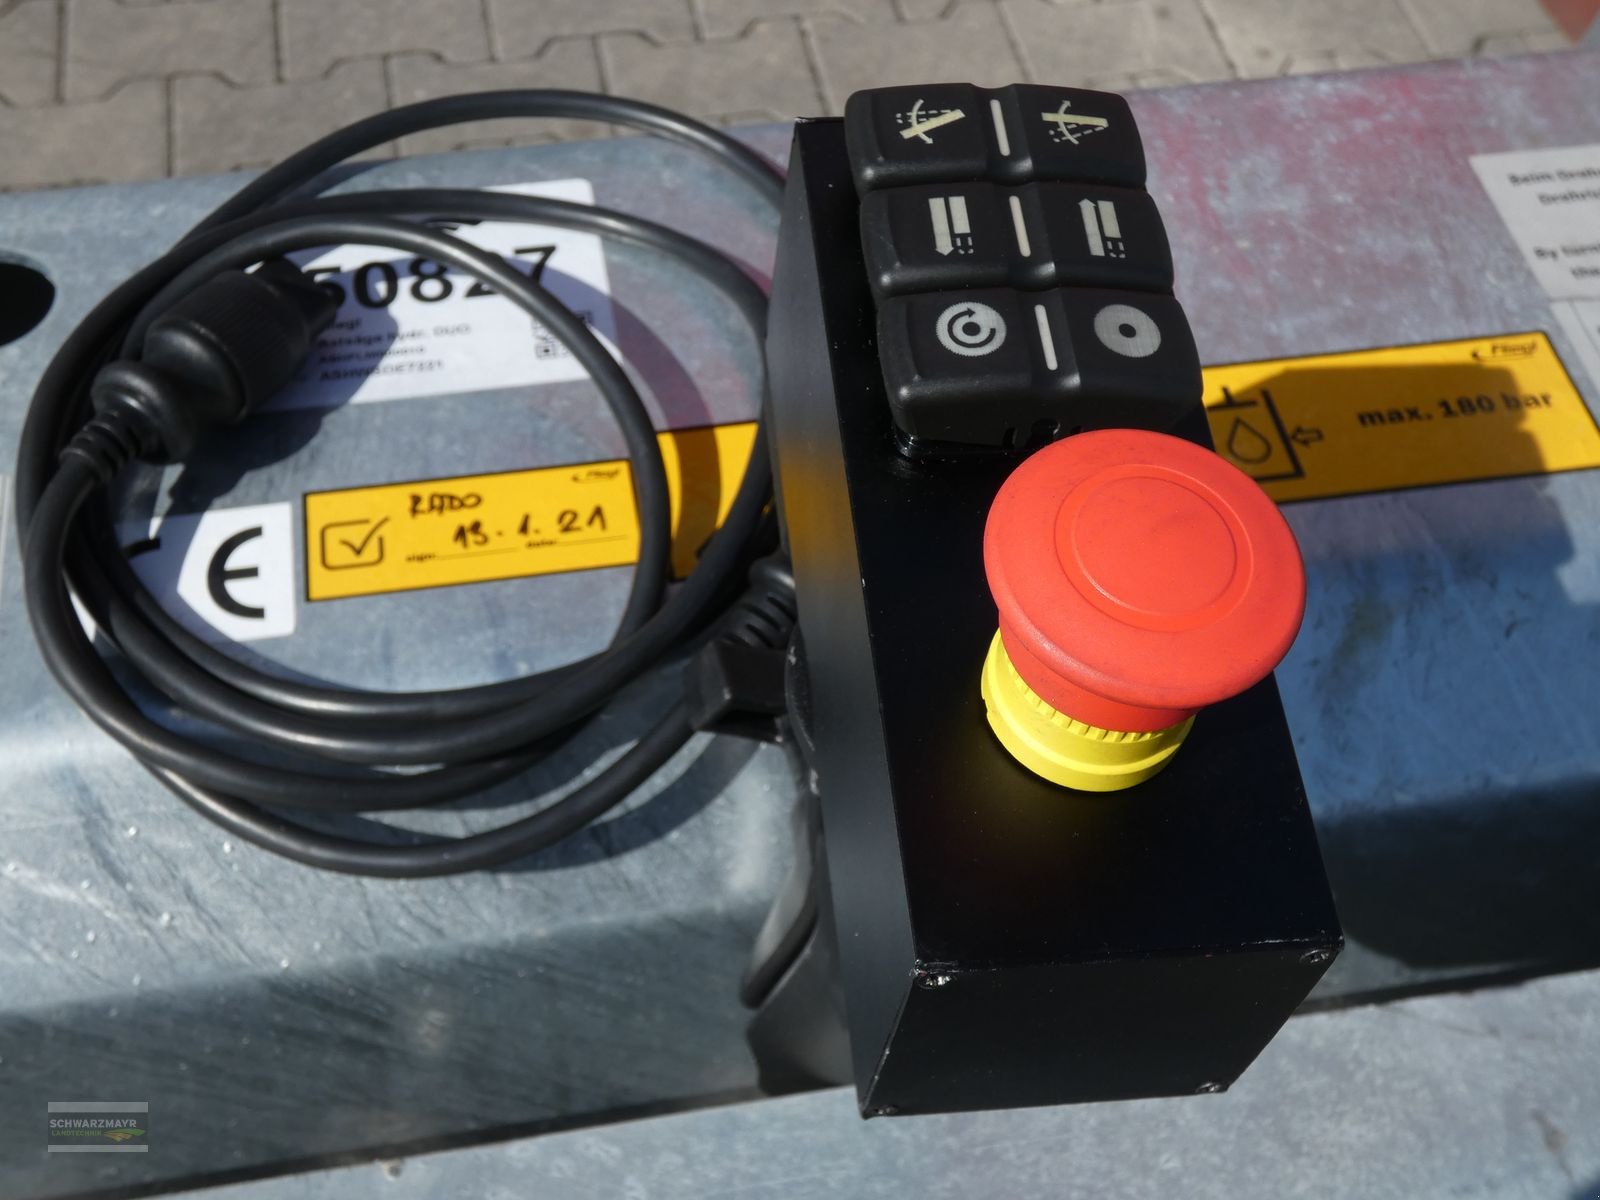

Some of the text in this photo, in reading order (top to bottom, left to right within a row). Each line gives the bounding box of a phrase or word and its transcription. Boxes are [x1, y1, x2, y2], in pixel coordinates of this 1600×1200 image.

[1357, 391, 1552, 427] max. 180 bar
